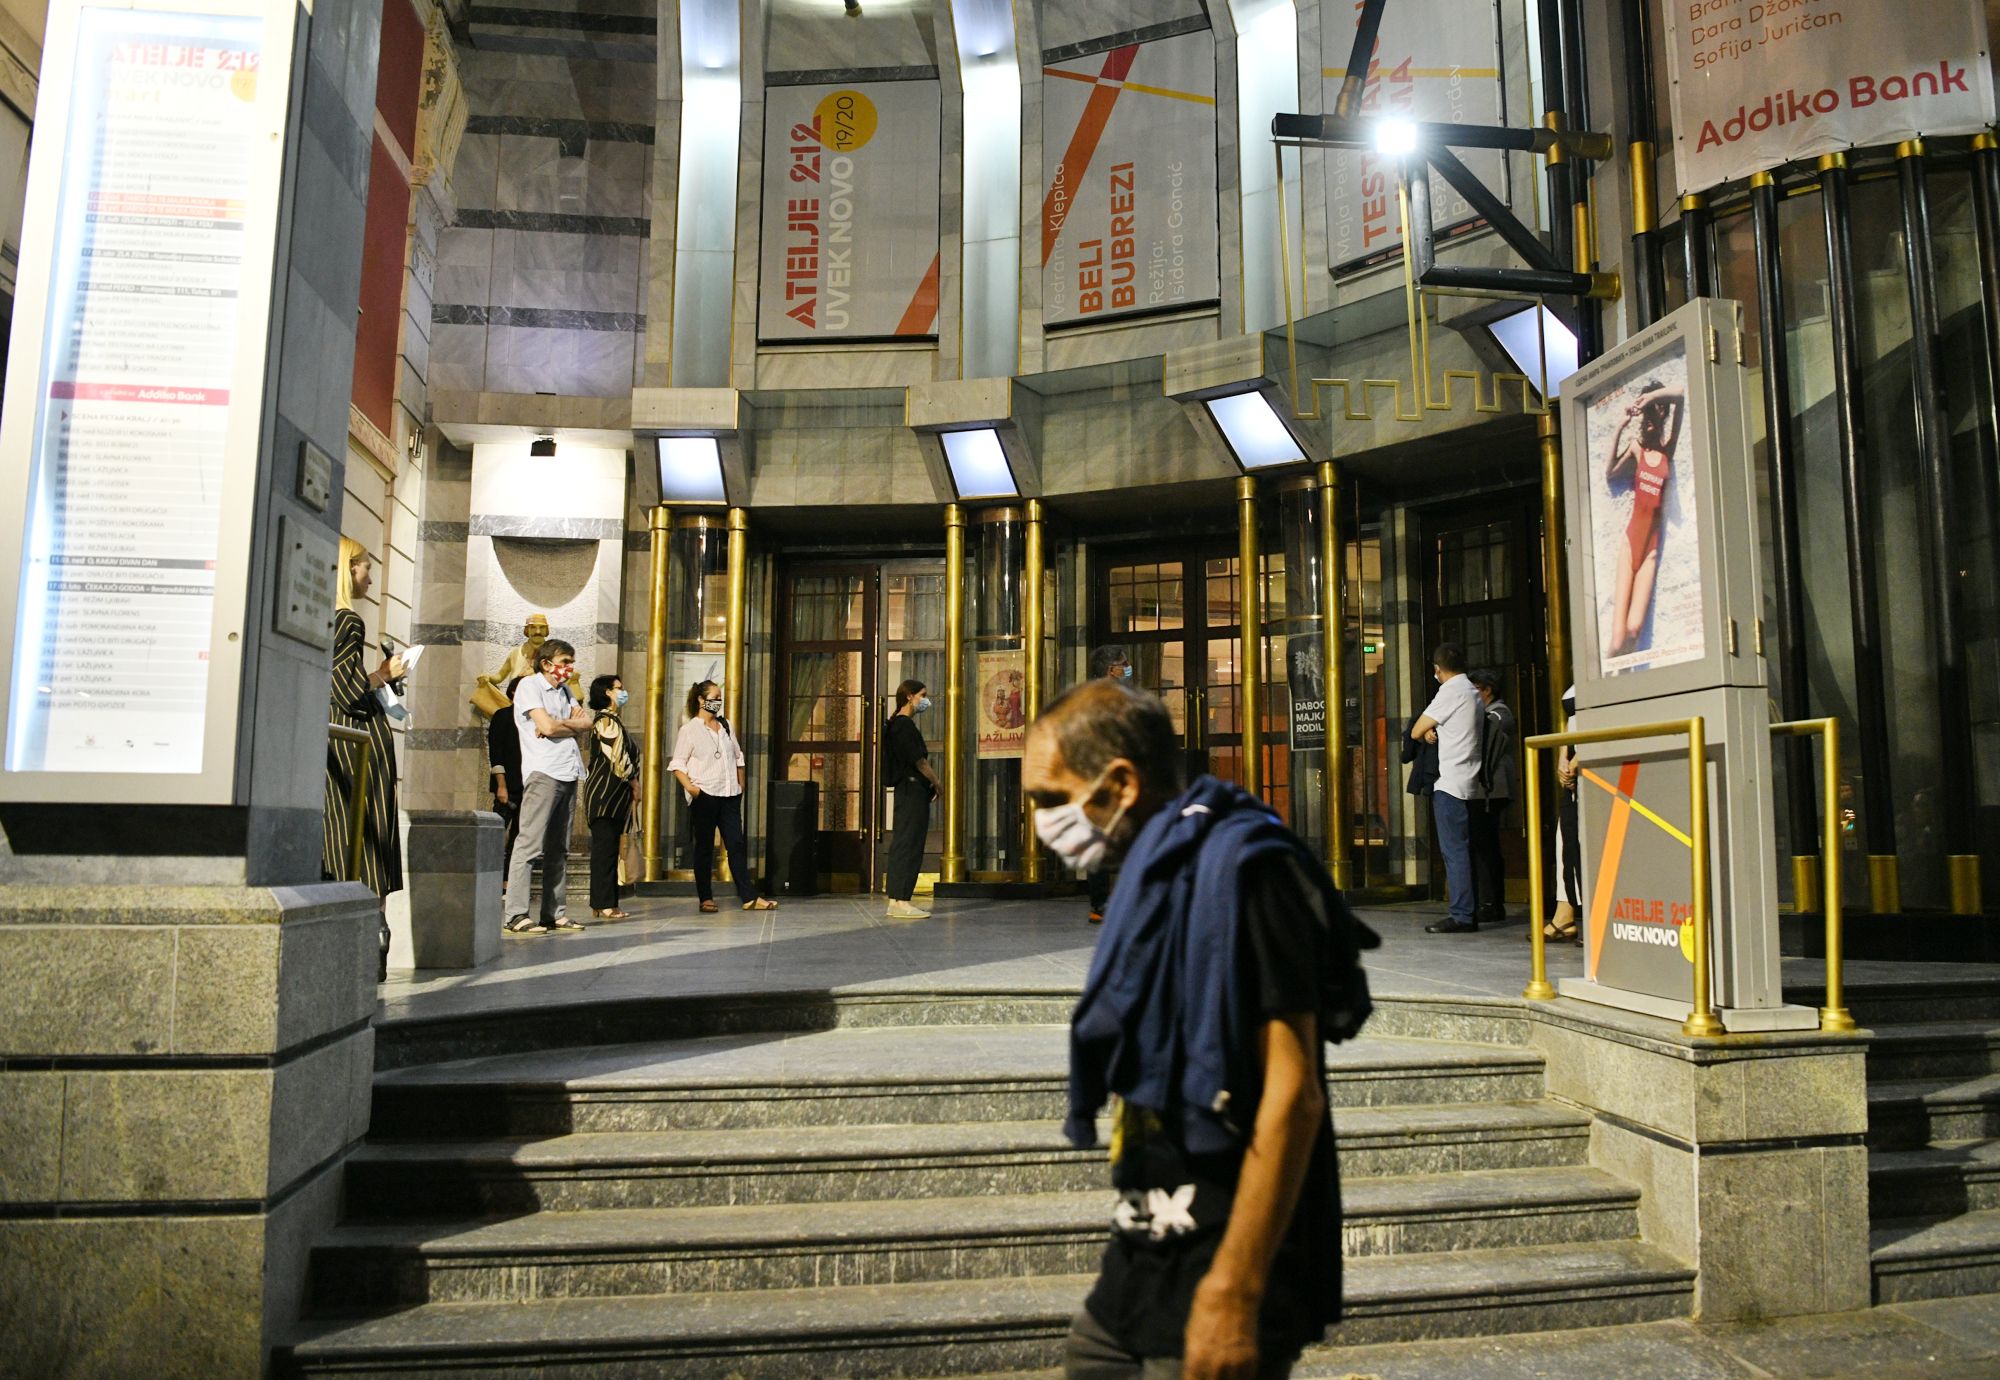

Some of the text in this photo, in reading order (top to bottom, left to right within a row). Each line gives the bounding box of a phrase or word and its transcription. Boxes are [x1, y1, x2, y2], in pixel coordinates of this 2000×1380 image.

[106, 44, 205, 69] ATELJE
[1691, 17, 1741, 46] Dara
[1693, 11, 1842, 70] Sofija Juričan
[162, 70, 226, 90] NOVO
[1696, 60, 1969, 154] Addiko Bank
[835, 96, 854, 151] 19/20
[825, 155, 854, 331] UVEK NOVO
[1050, 163, 1068, 320] Vedrana Klepica
[1110, 161, 1136, 309] BUBREZI
[1335, 203, 1353, 260] Maja
[785, 199, 820, 330] ATELJE
[1079, 238, 1103, 315] BELI
[1149, 239, 1168, 306] Režija:
[1168, 233, 1185, 301] Isidora
[138, 390, 177, 400] Addiko
[178, 391, 206, 402] Bank
[978, 730, 1023, 743] LAŽLJIV
[1296, 723, 1325, 733] RODIL
[1613, 922, 1679, 947] UVEK NOVO
[1614, 897, 1665, 924] ATELJE
